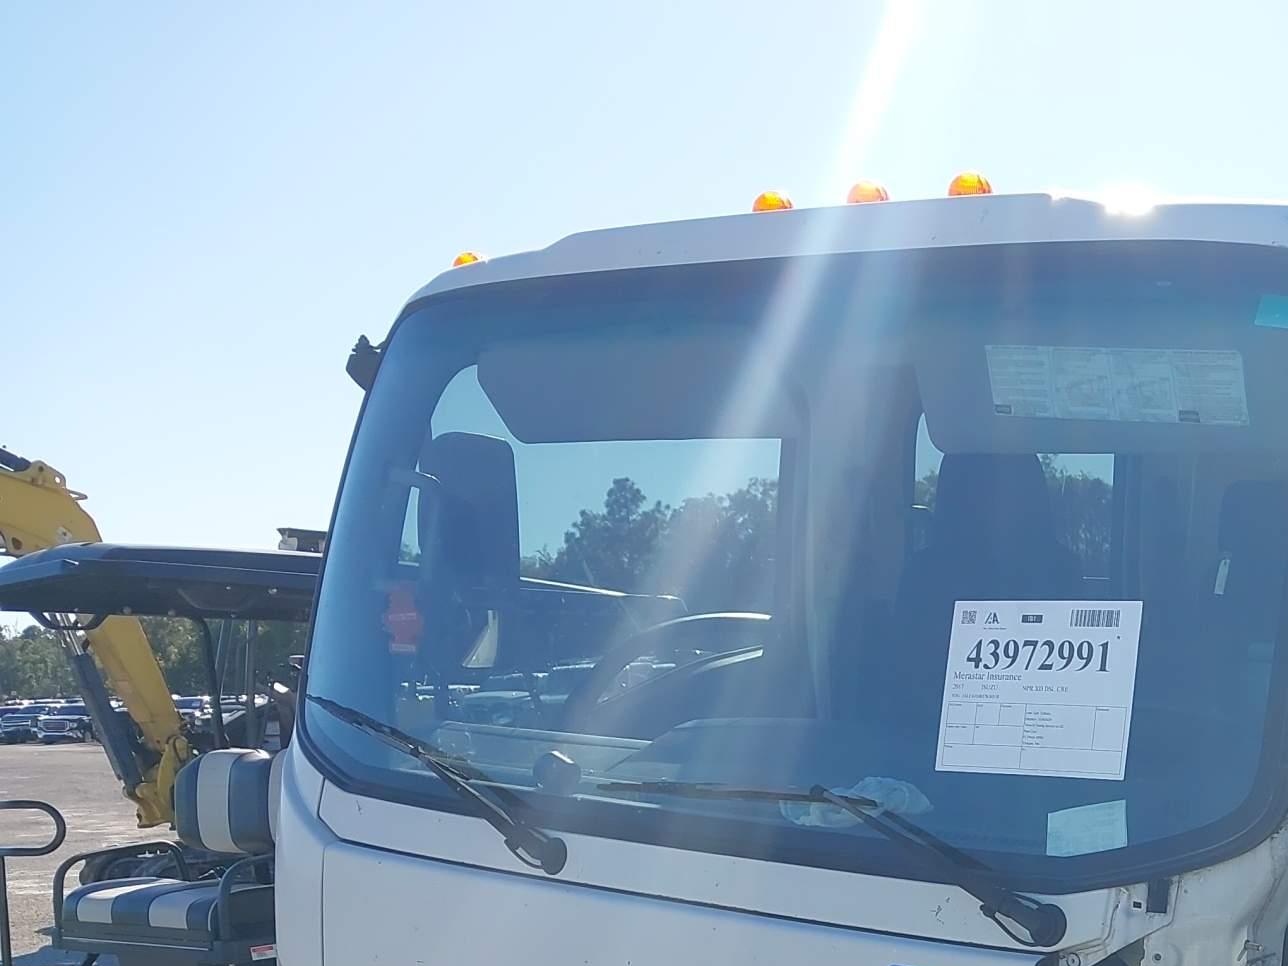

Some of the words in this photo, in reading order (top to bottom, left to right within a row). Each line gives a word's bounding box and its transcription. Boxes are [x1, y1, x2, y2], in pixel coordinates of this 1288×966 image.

[966, 638, 1110, 673] 43972991
[953, 671, 986, 680] Merastar
[987, 671, 1022, 681] Insurance
